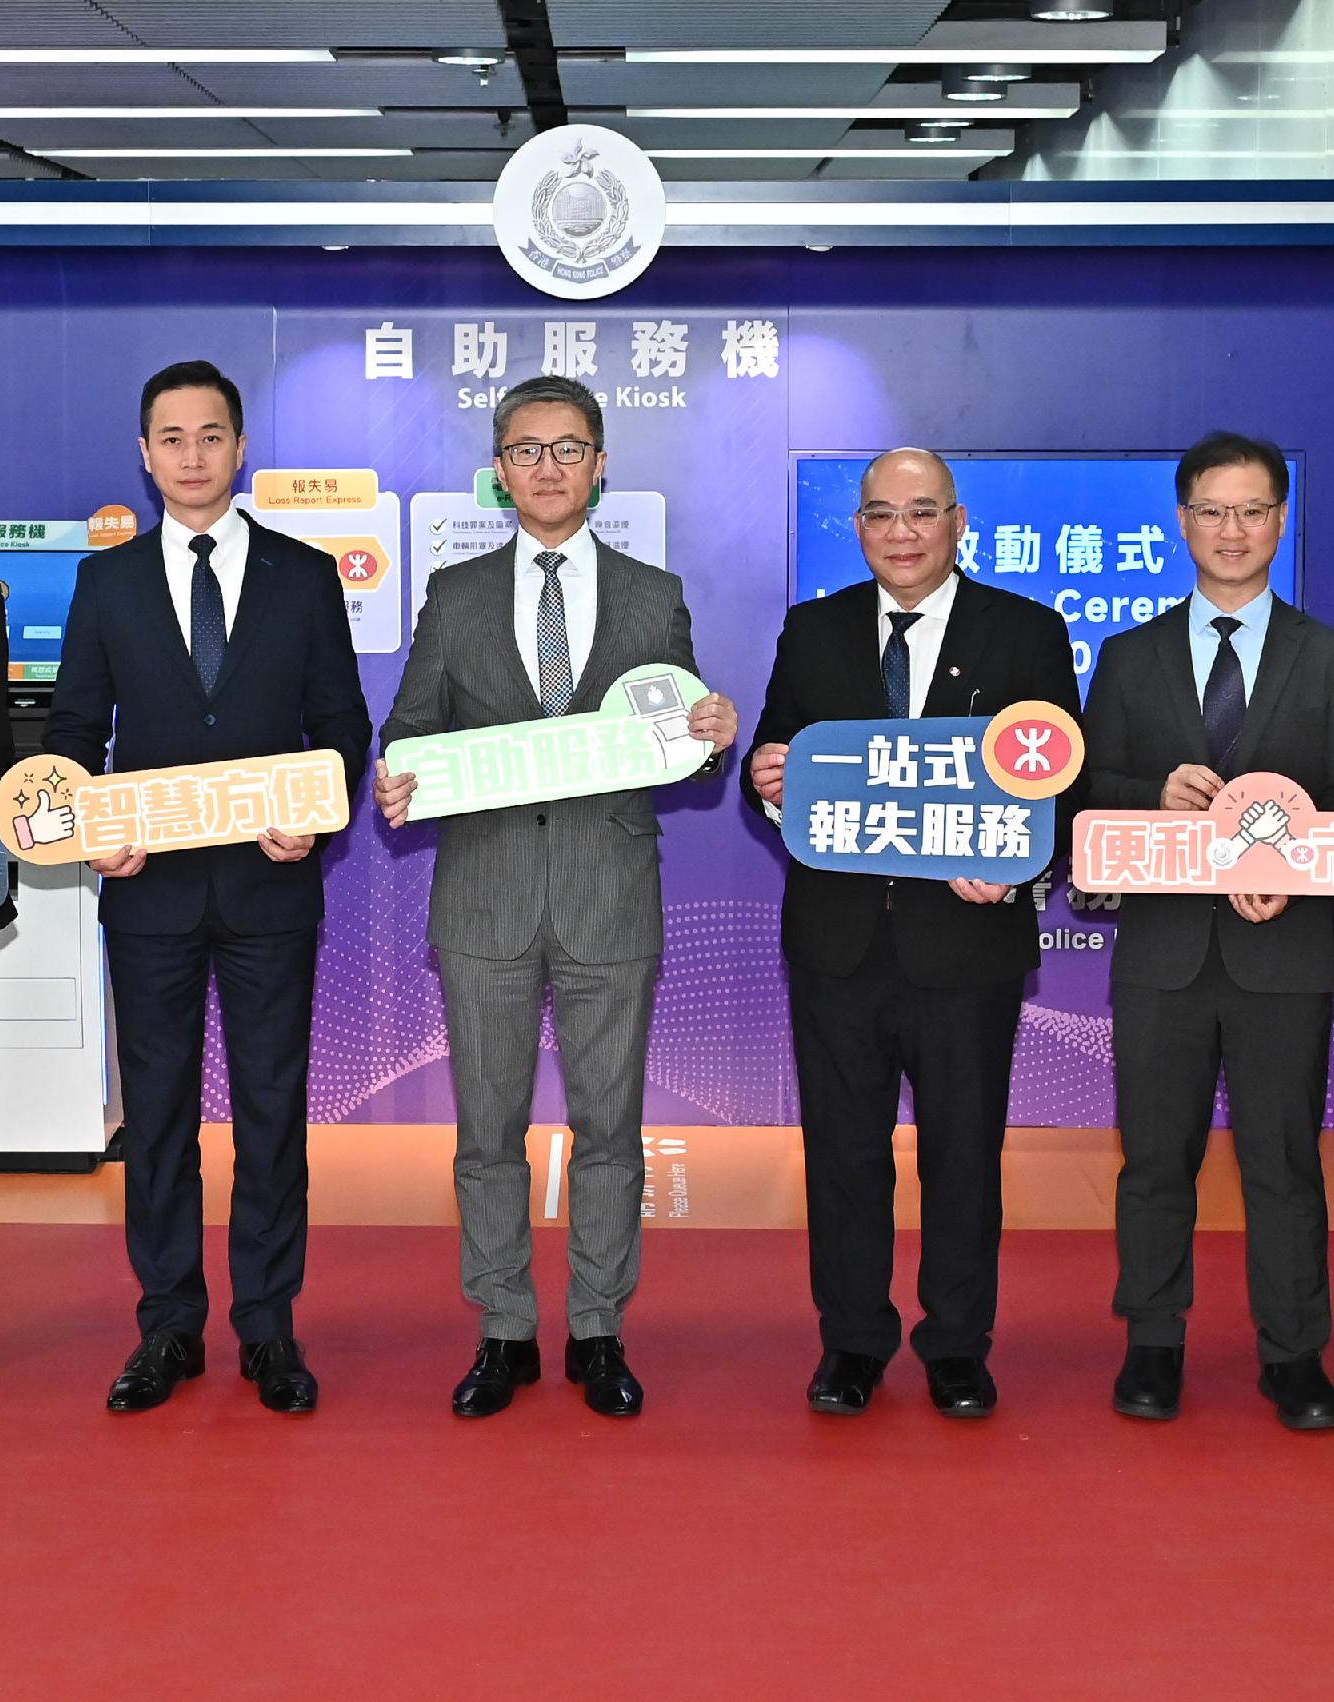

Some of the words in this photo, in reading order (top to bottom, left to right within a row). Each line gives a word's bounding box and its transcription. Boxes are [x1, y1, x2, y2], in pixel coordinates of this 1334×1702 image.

[364, 319, 780, 380] 自助服務機
[616, 386, 687, 408] Kiosk
[268, 496, 291, 505] Loss
[293, 496, 323, 506] Report
[326, 495, 362, 505] Express
[292, 479, 338, 494] 報失易
[10, 540, 30, 548] Kiosk
[401, 714, 660, 806] 自助服務
[811, 735, 976, 790] 一站式
[75, 760, 340, 853] 智慧方便
[809, 800, 1032, 858] 報失服務
[1084, 820, 1216, 886] 便利
[1038, 928, 1104, 950] olice
